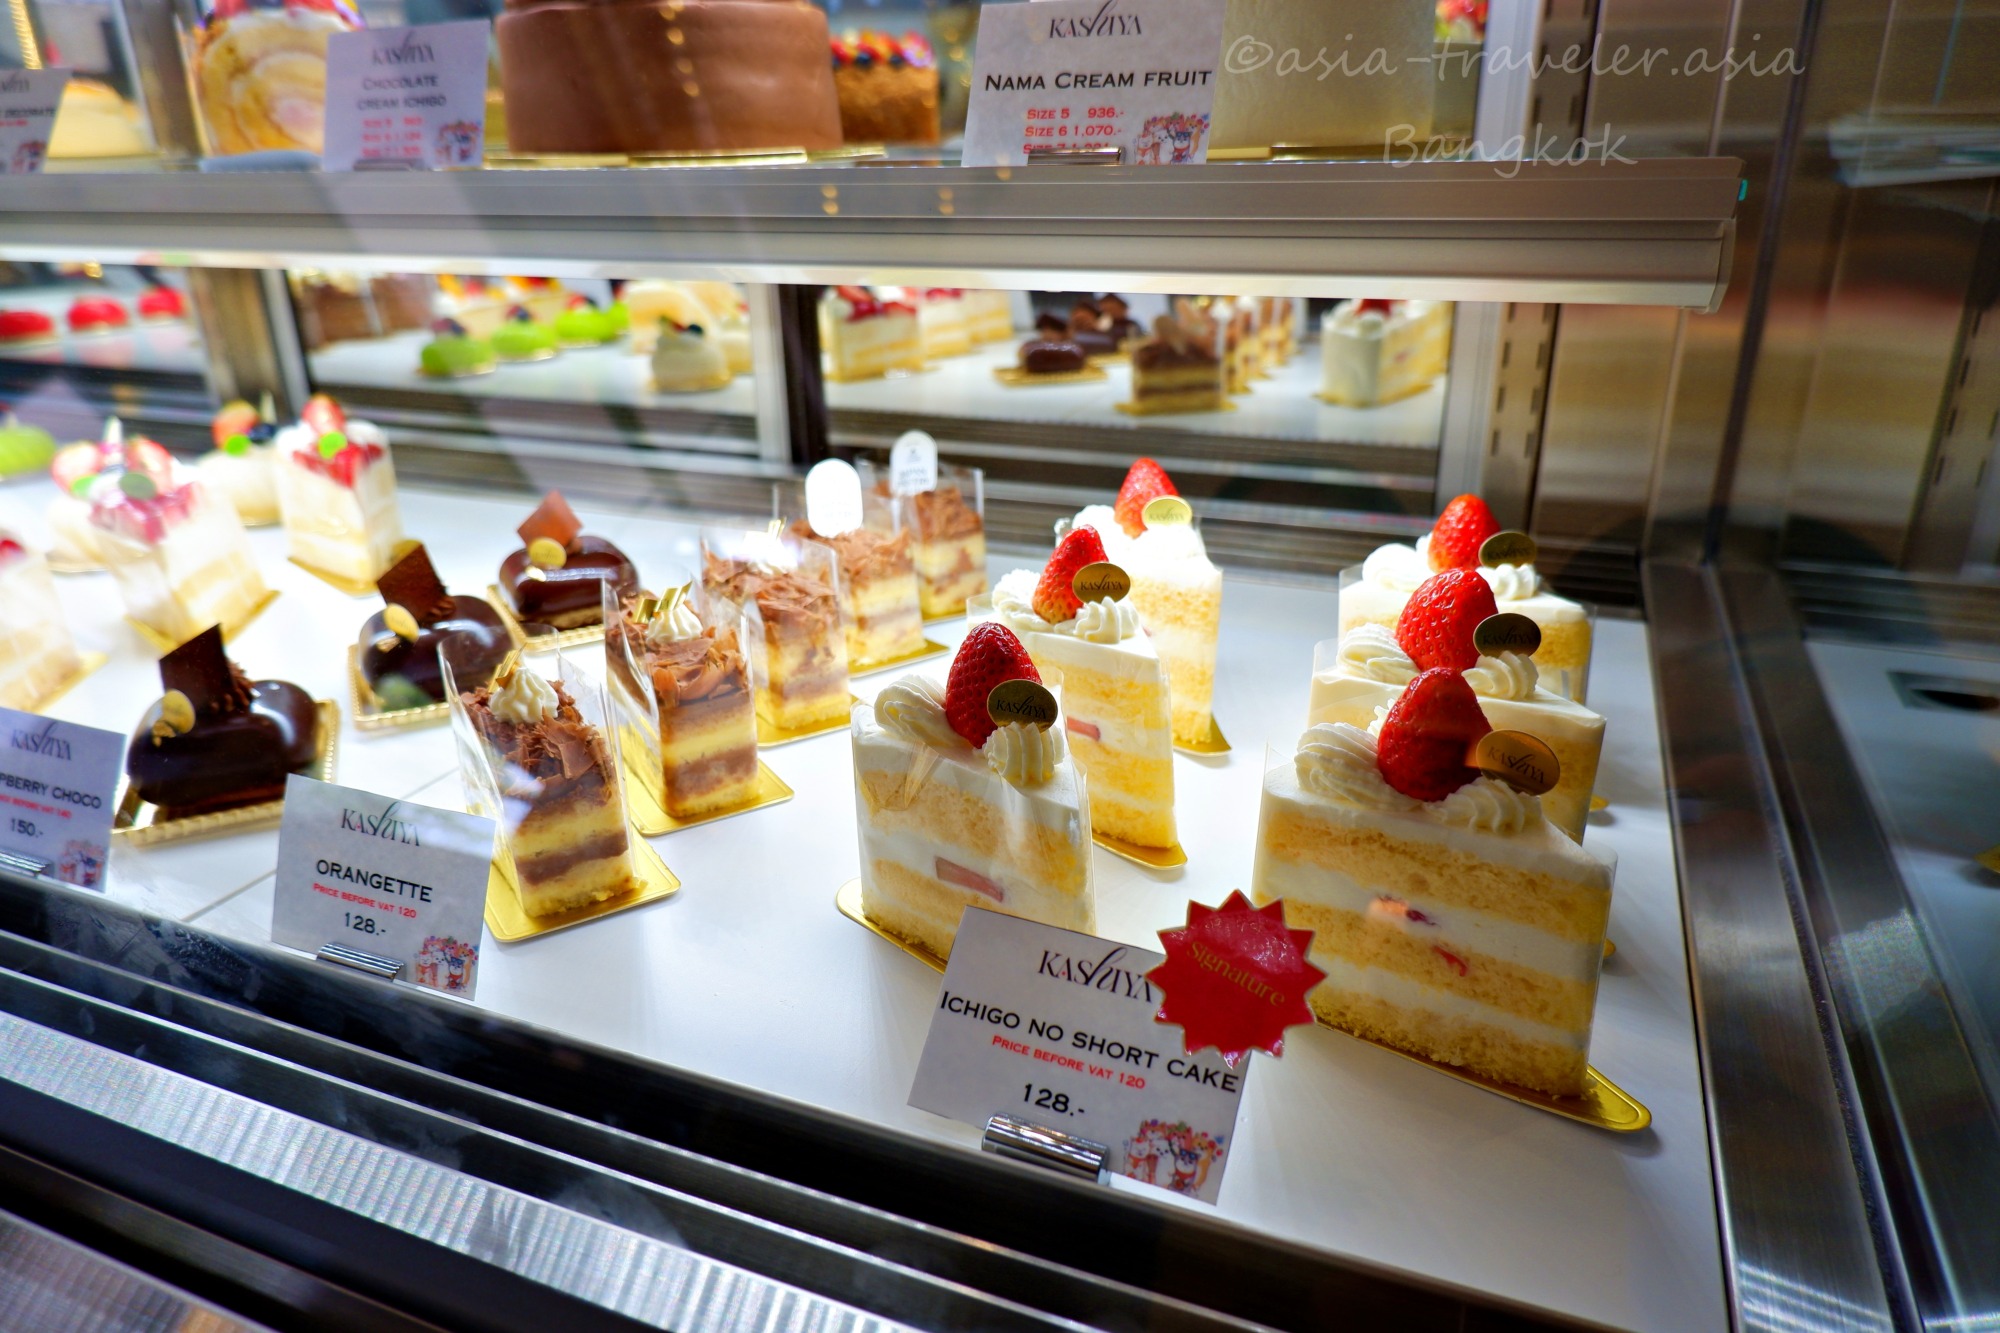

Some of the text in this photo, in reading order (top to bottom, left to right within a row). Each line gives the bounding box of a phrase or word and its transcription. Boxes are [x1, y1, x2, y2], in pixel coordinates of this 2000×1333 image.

[985, 70, 1212, 91] NAMA CREAM FRUIT
[1027, 107, 1124, 119] SIZE 5 936.-
[1025, 126, 1054, 137] SIZE
[1058, 126, 1068, 136] 6
[52, 786, 102, 809] CHOCO
[316, 859, 434, 903] ORANGETTE
[312, 883, 417, 919] PRICE BEFORE VAT 120
[344, 911, 387, 936] 128.-
[1186, 940, 1286, 1007] Signature
[940, 990, 1241, 1095] ICHIGO NO SHORT CAKE
[991, 1034, 1147, 1091] PRICE BEFORE VAT 120
[1020, 1082, 1086, 1117] 128.-
